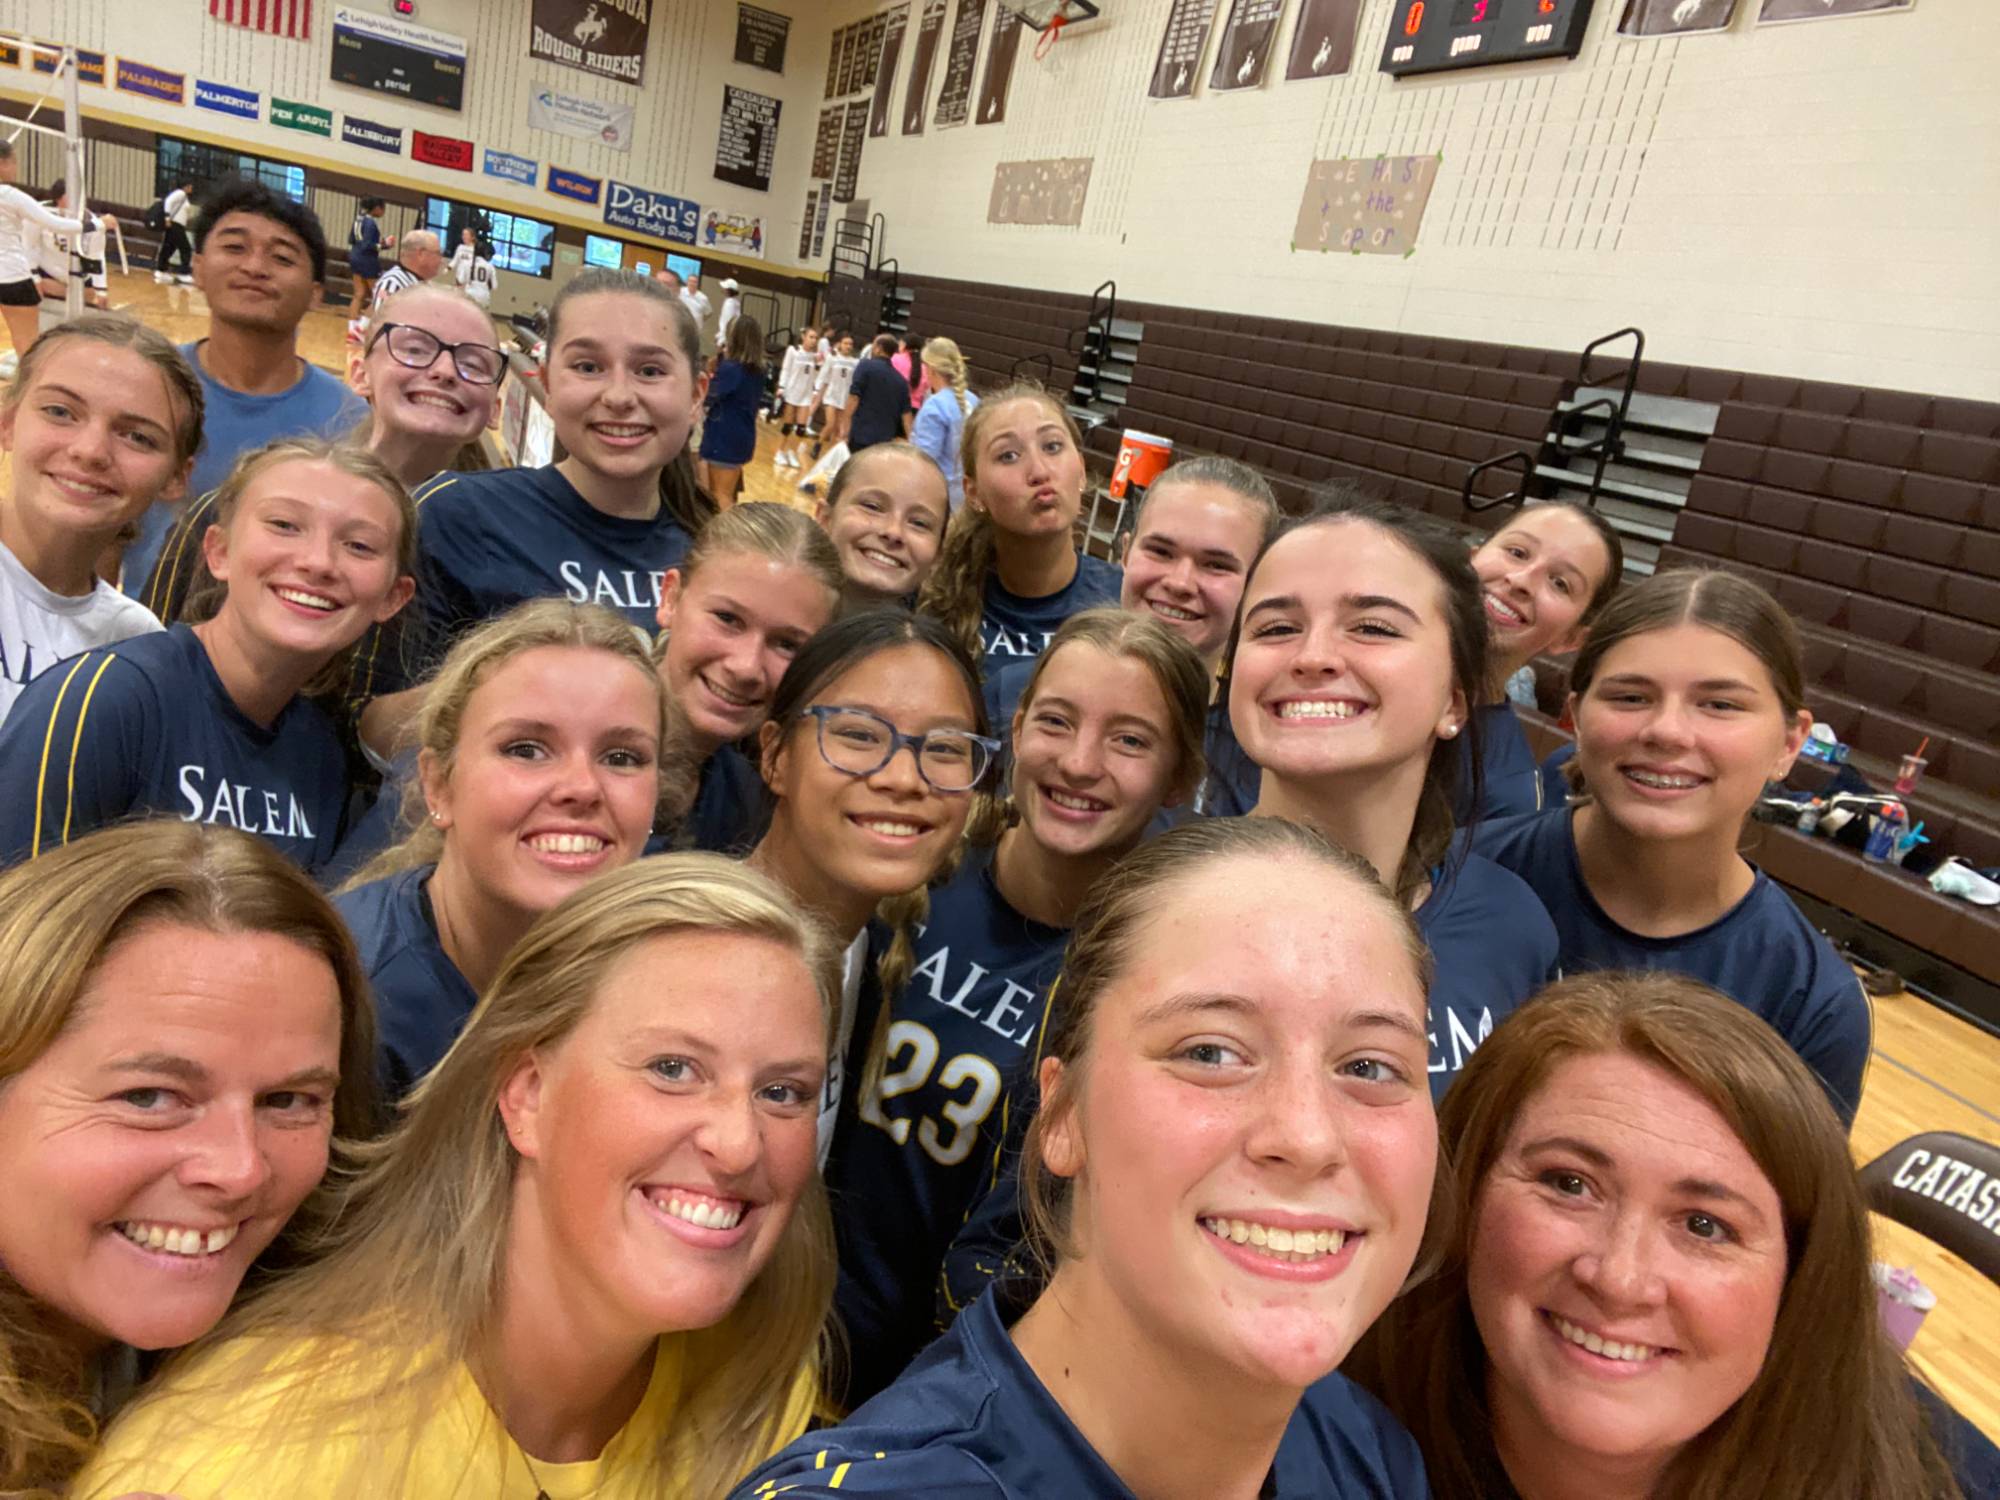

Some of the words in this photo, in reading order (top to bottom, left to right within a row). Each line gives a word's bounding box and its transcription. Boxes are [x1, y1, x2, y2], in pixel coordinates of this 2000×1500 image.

[1405, 1, 1424, 35] 0
[339, 35, 362, 50] Home
[350, 14, 379, 28] Lehigh
[380, 22, 402, 35] Valley
[404, 29, 429, 41] Health
[431, 35, 464, 50] Network
[532, 25, 582, 62] ROUGH
[586, 51, 641, 79] RIDERS
[119, 70, 183, 94] PALISADES
[385, 79, 411, 92] period
[196, 88, 259, 111] PALMERTON
[272, 107, 293, 119] PEN
[296, 113, 332, 128] ARGYL
[344, 124, 400, 147] SALISBURY
[556, 177, 593, 195] WILSON
[610, 184, 697, 228] Daku's
[608, 210, 635, 225] Auto
[637, 219, 665, 236] Body
[667, 226, 694, 241] Shop
[1119, 449, 1132, 466] G
[859, 1020, 1001, 1166] 23
